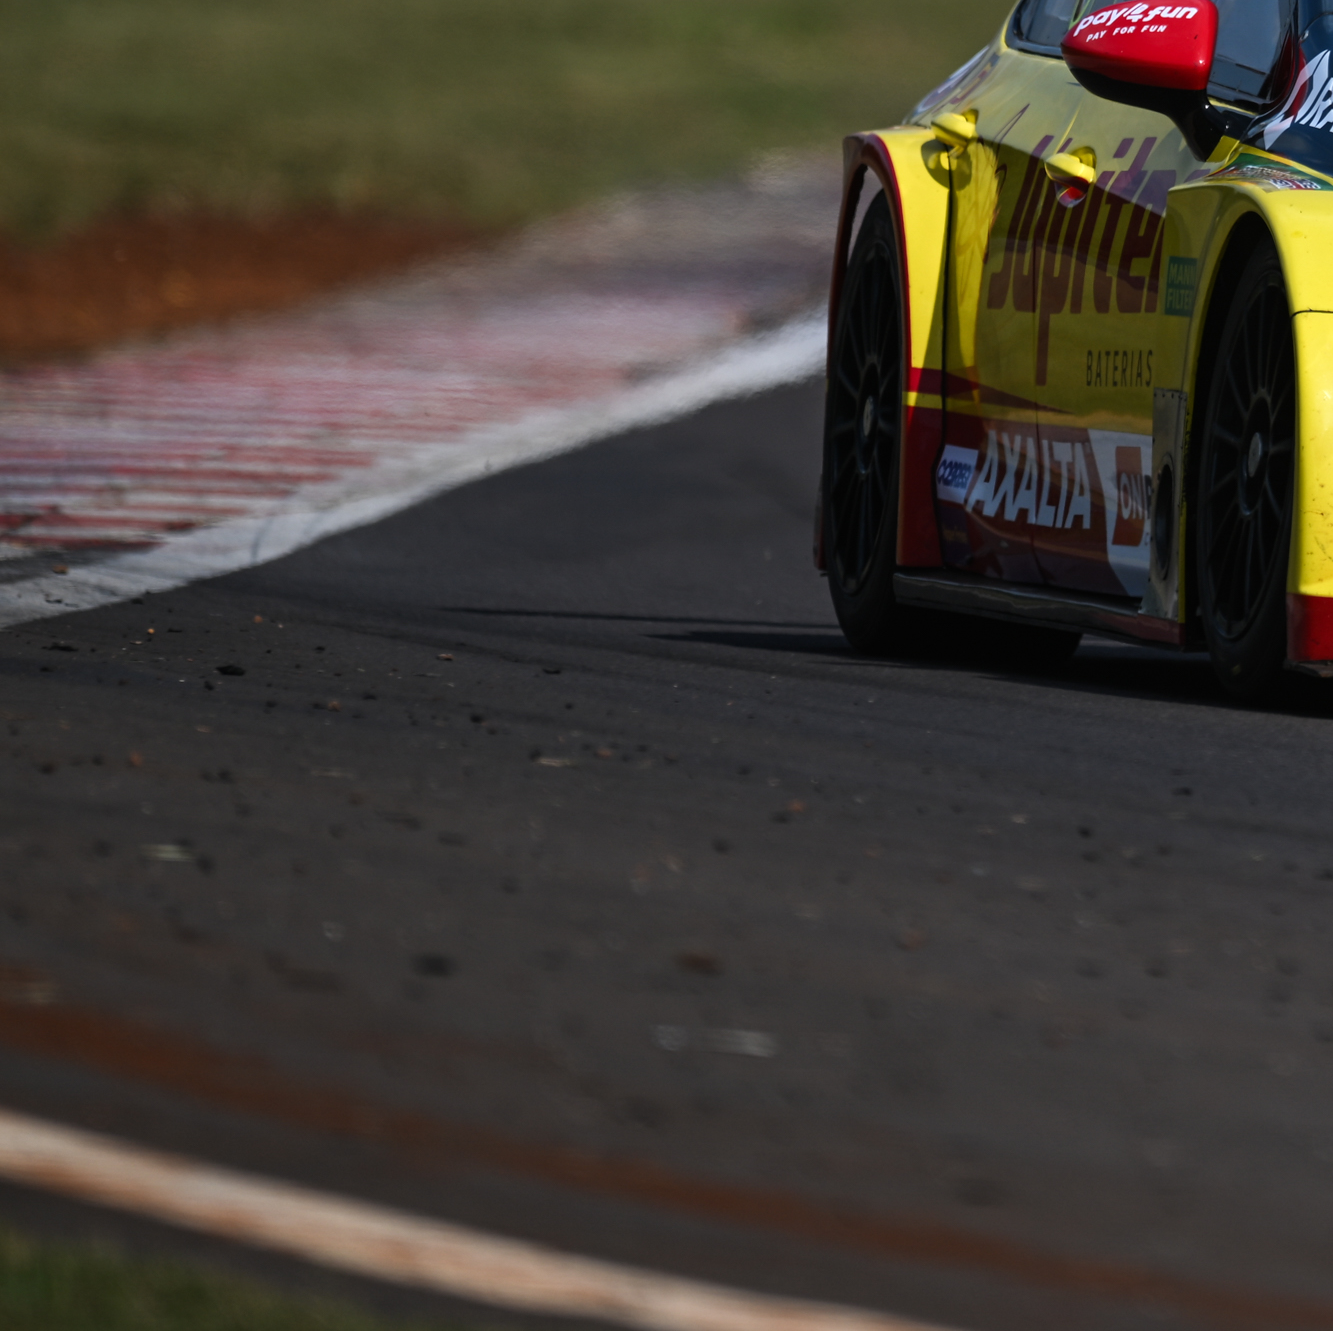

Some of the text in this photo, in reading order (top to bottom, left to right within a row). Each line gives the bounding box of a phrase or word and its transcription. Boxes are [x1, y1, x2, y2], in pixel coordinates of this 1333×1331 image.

[1086, 25, 1167, 43] PAY FOR FUN
[1087, 349, 1154, 387] BATERIAS
[965, 429, 1091, 530] AXALTA
